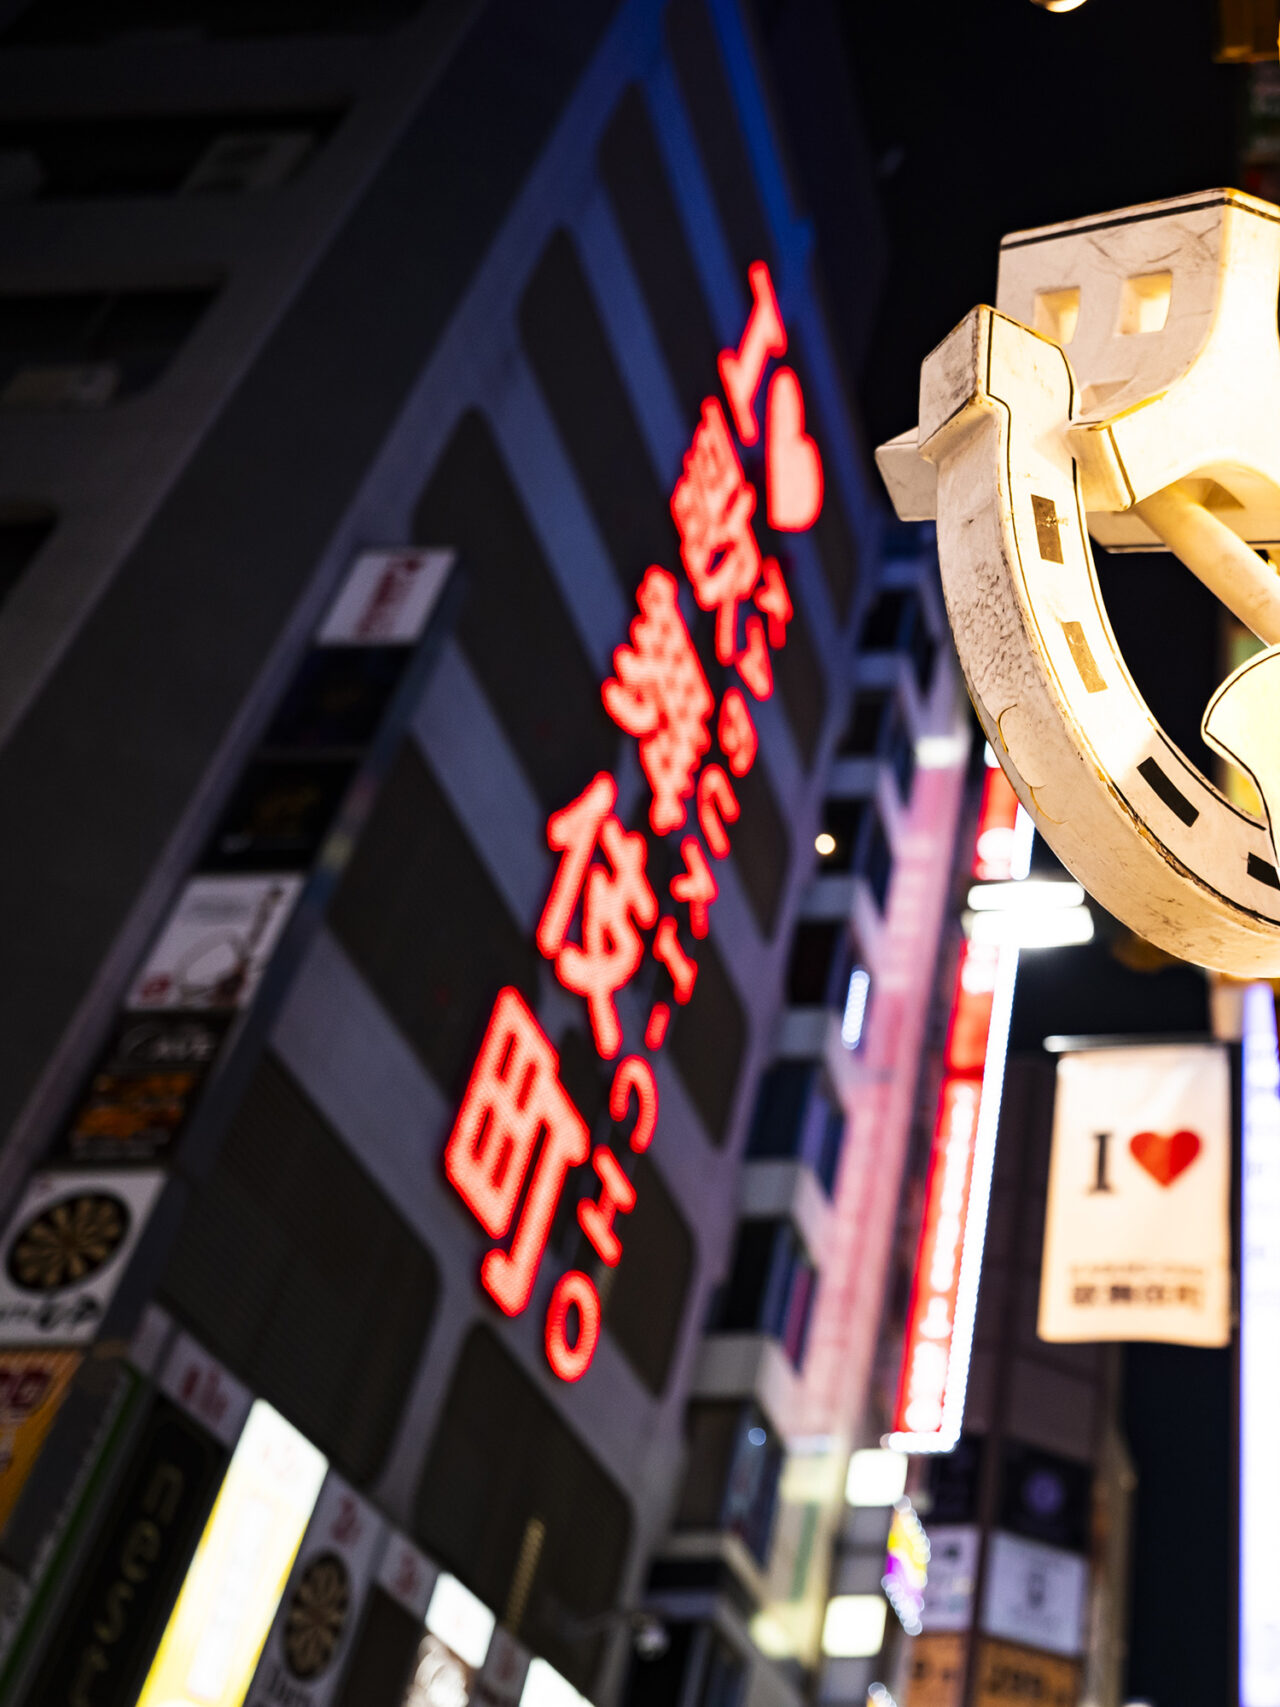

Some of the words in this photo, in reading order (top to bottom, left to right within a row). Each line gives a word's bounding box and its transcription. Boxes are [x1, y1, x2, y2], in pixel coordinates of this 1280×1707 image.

[444, 395, 762, 1317] 歌舞伎町
[1087, 1130, 1114, 1195] I
